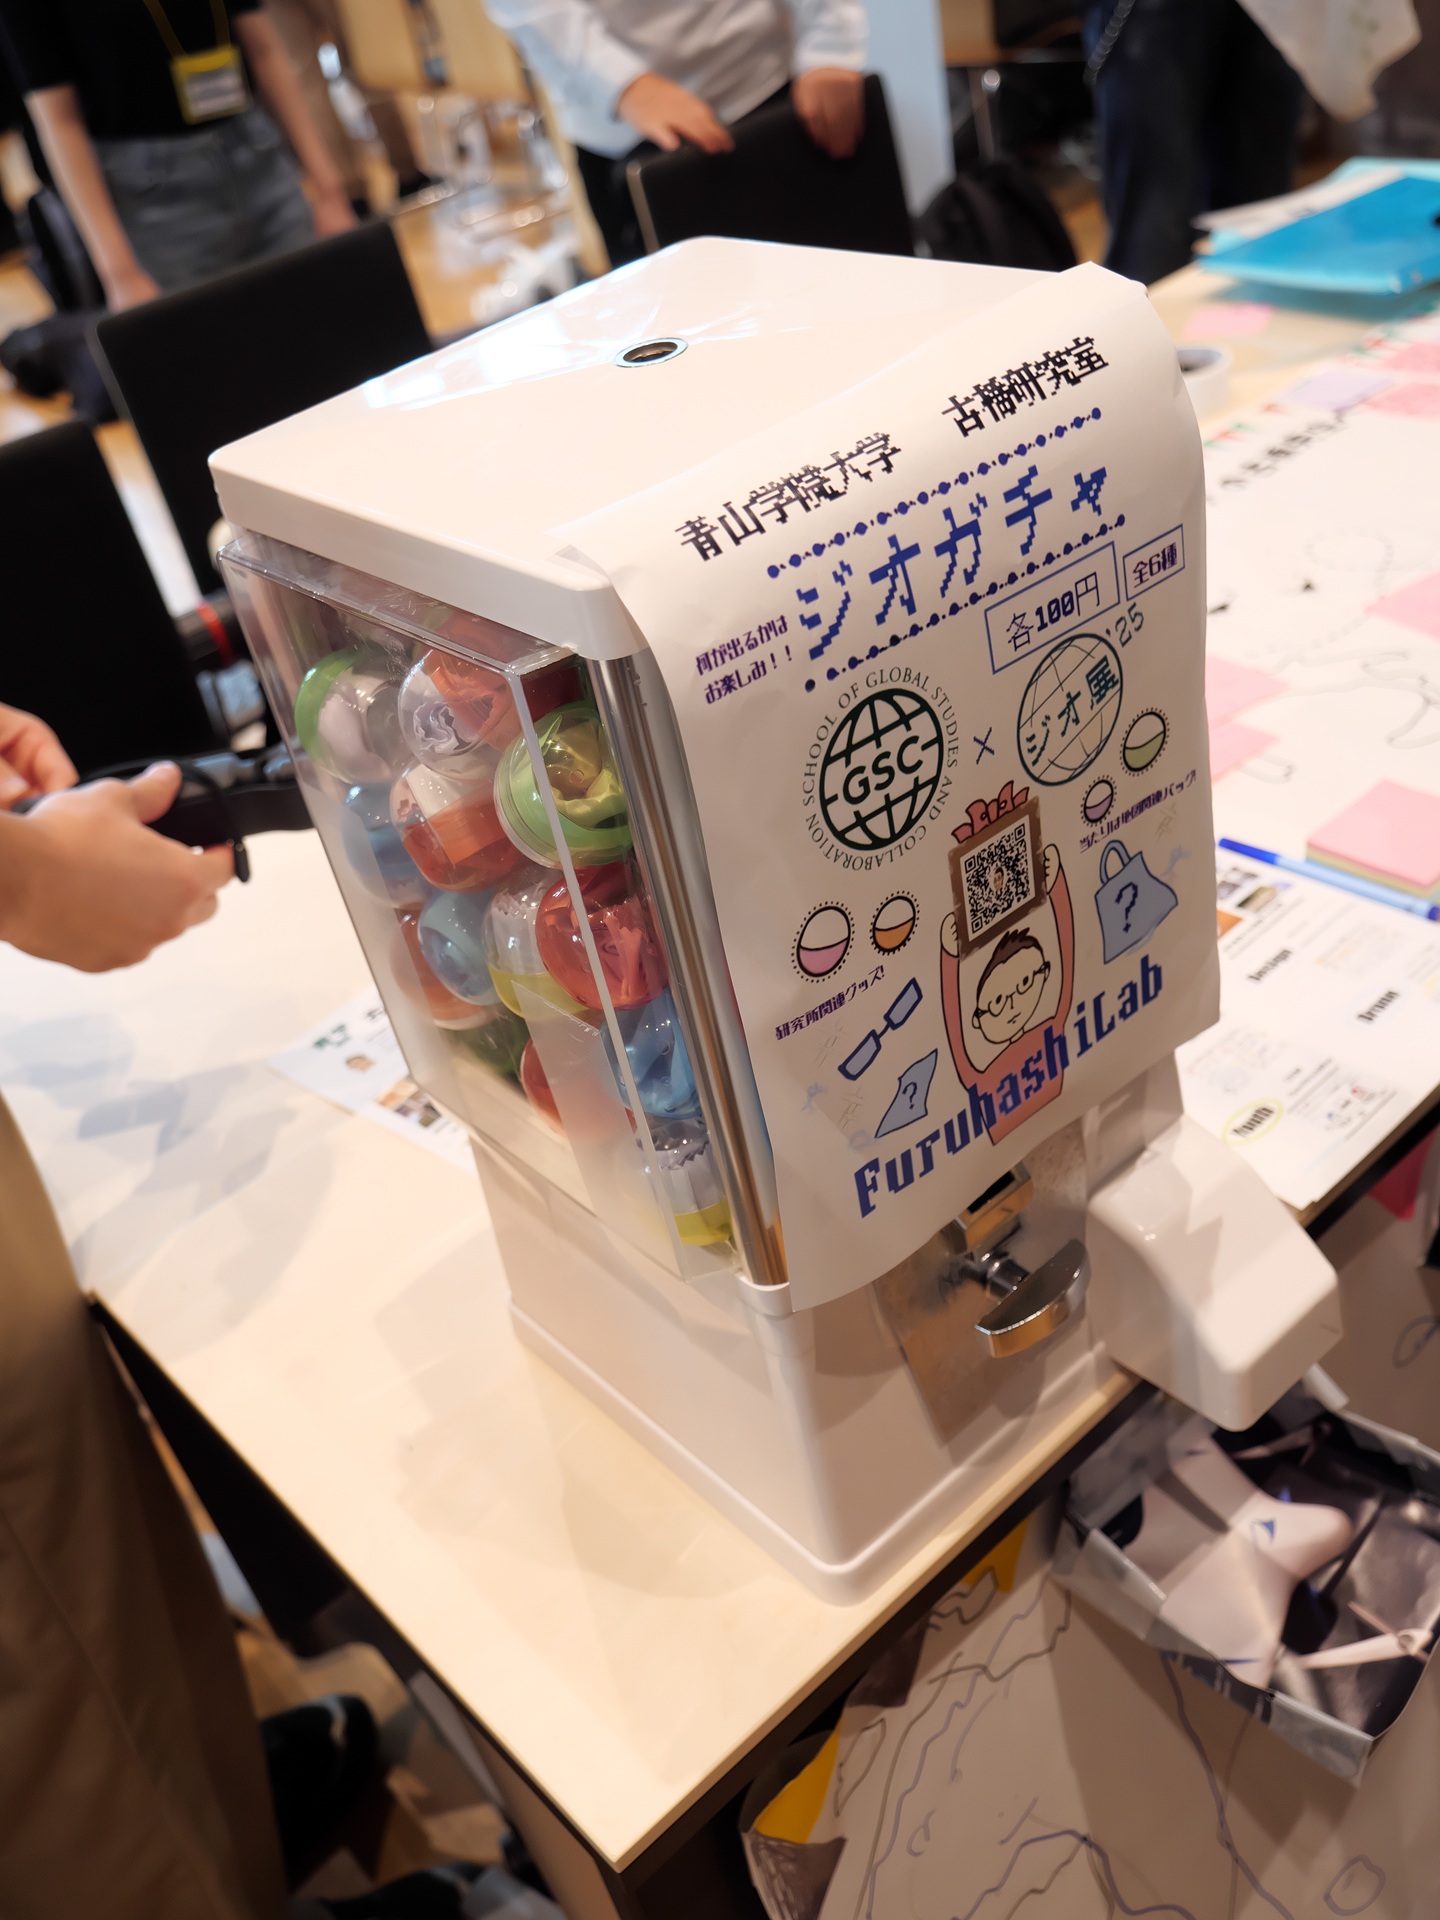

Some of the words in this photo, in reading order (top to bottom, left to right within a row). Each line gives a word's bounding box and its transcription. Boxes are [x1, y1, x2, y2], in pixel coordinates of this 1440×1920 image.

[675, 432, 901, 561] 青山学院大学
[941, 336, 1109, 437] 古橋研究室
[797, 465, 1107, 661] ジオガチャ
[1133, 542, 1178, 588] 全6種
[696, 614, 788, 676] 何が出るかは
[1006, 572, 1100, 651] 各100円
[838, 682, 860, 709] OF
[865, 667, 929, 692] GLOBAL
[1026, 654, 1119, 767] ジオ展
[802, 714, 837, 807] SCHOOL
[931, 686, 959, 768] STUDIES
[843, 735, 923, 805] GSC
[928, 775, 953, 821] AND
[805, 813, 927, 871] COLLABORATION
